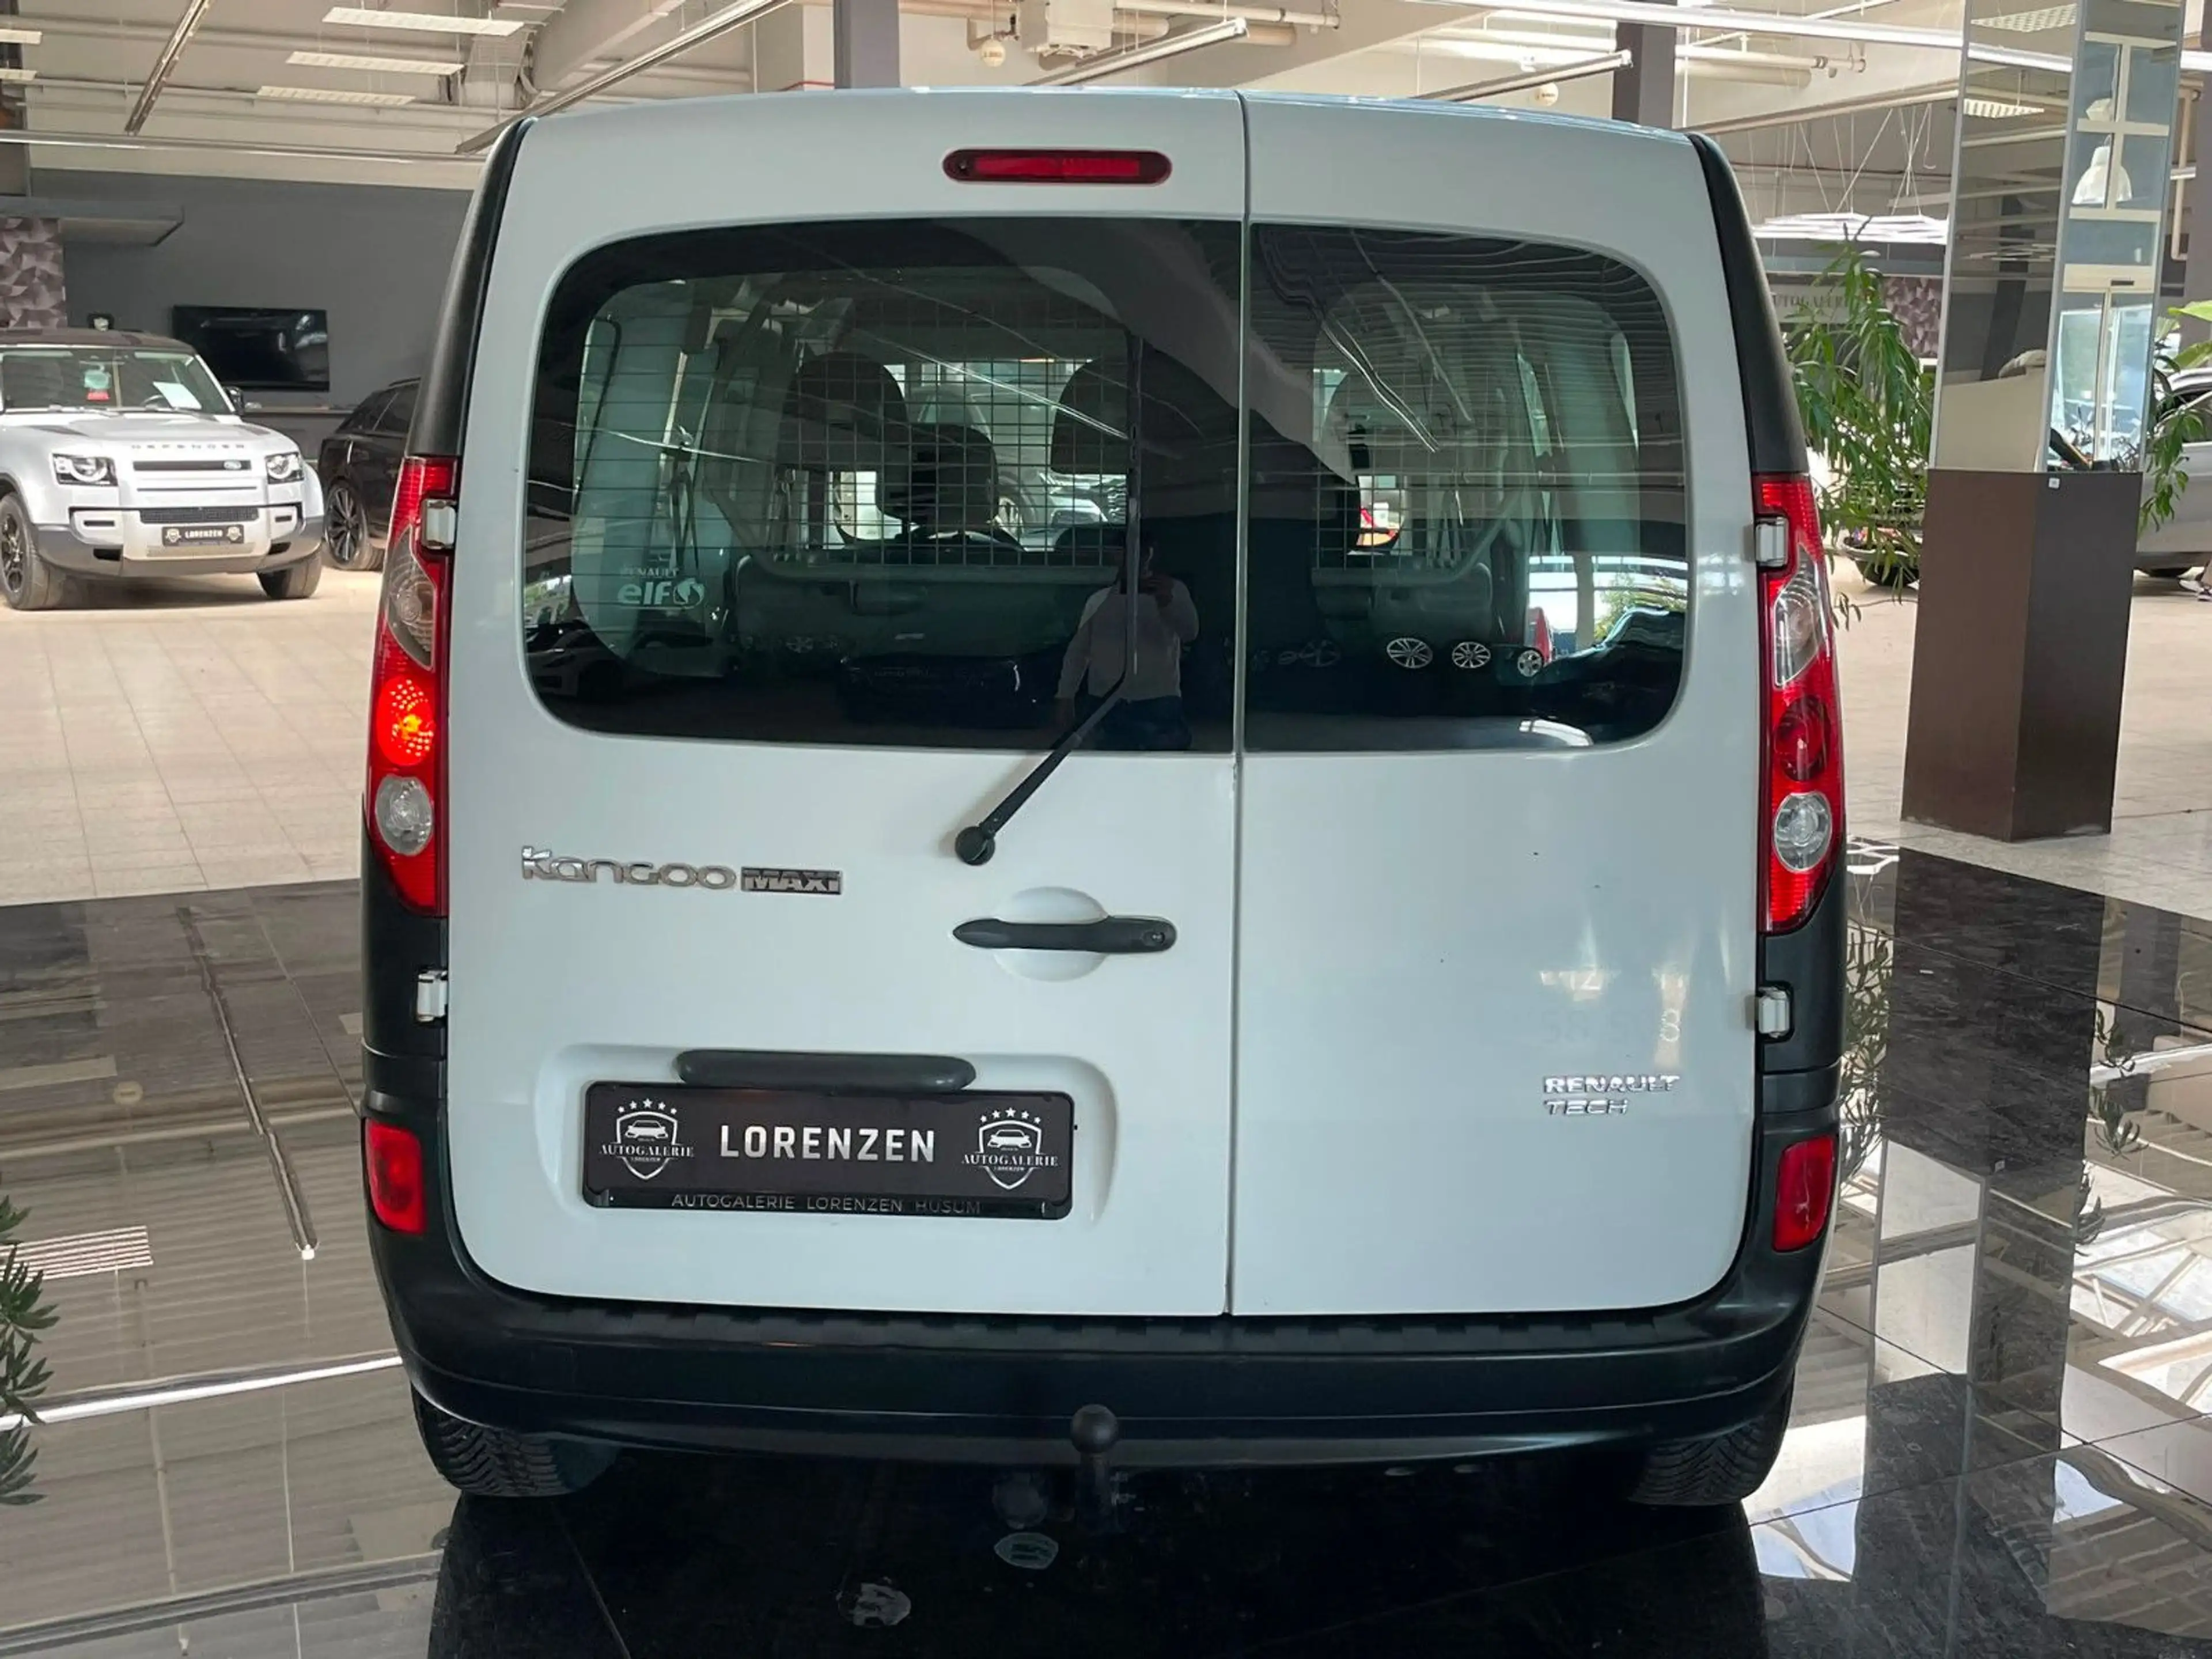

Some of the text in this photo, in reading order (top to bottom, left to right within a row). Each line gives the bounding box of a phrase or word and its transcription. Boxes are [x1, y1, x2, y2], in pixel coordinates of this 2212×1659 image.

[618, 581, 672, 605] elf
[743, 868, 840, 893] MAXI
[1544, 1074, 1680, 1093] RENAULT
[1544, 1099, 1628, 1115] TECH
[599, 1143, 695, 1157] AUTOGALERIE
[721, 1124, 934, 1162] LORENZEN
[961, 1154, 1059, 1166] AUTOGALERIE
[672, 1194, 980, 1214] AUTOGALERIE LORENZEN HUSUM
